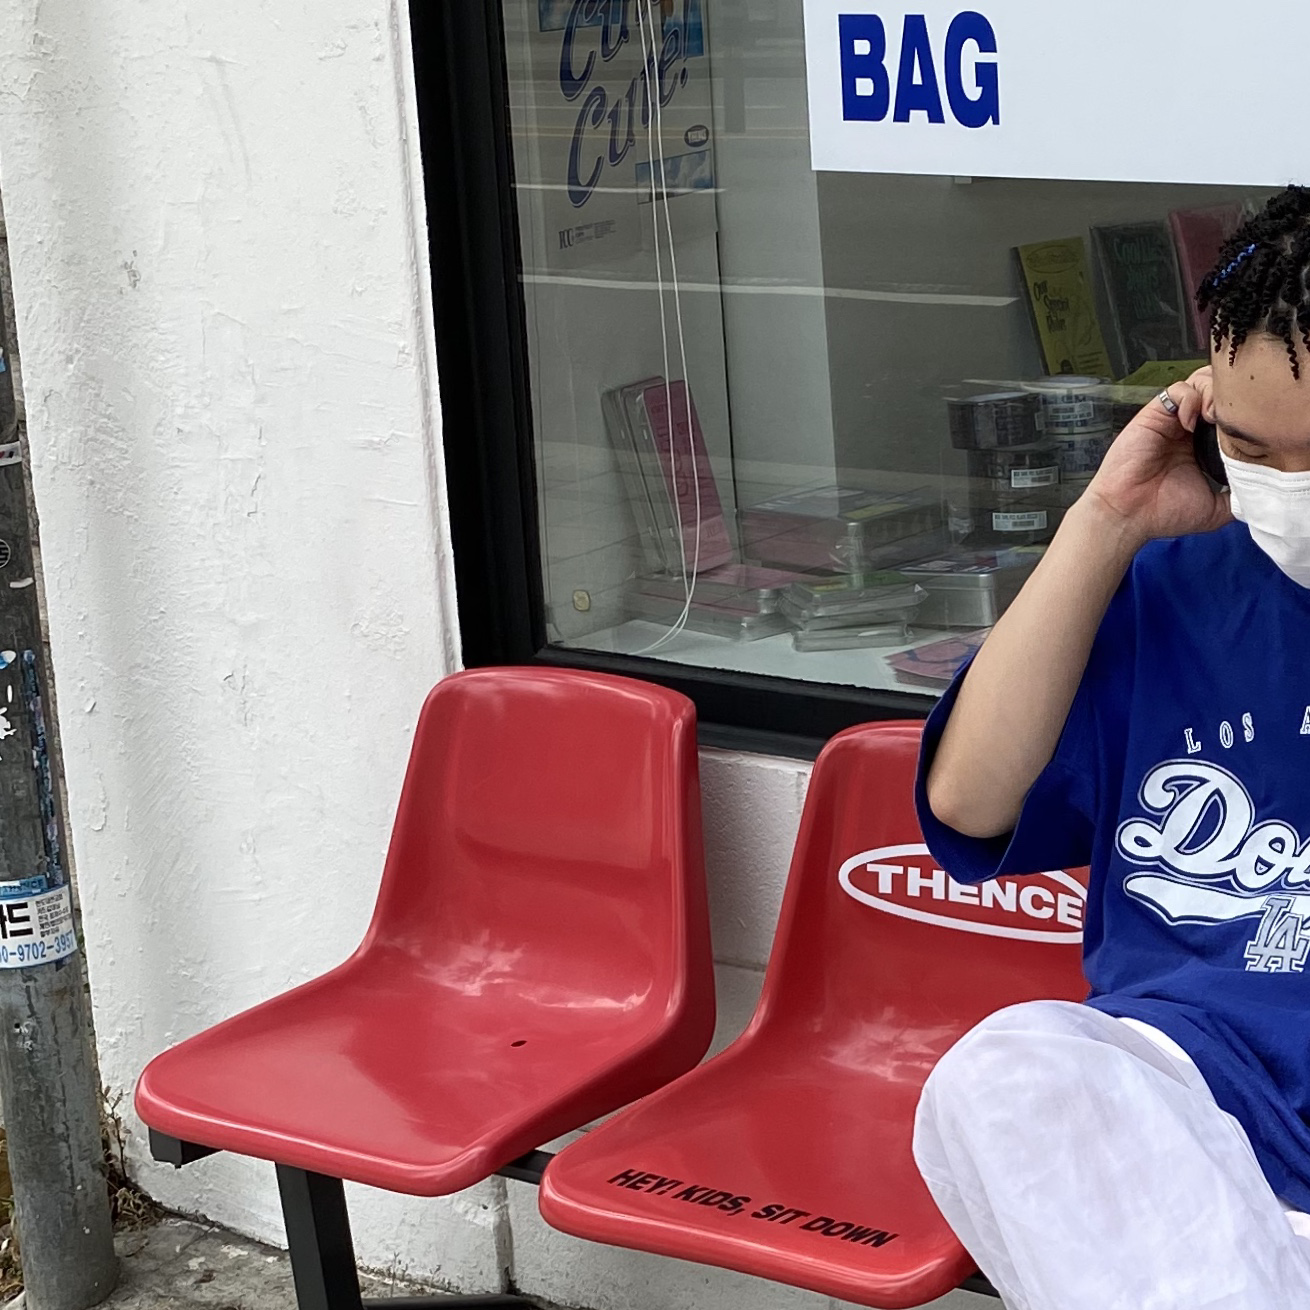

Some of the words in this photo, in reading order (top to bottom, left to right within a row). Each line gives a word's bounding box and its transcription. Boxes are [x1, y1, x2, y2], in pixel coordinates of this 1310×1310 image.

[838, 11, 1000, 128] BAG
[1183, 712, 1256, 754] LOS
[0, 902, 33, 939] 드
[866, 863, 1084, 930] THENCE
[0, 929, 73, 963] 0-9702-3957
[607, 1168, 684, 1195] HEY!
[671, 1184, 752, 1216] KIDS,
[751, 1204, 811, 1225] SIT
[799, 1216, 899, 1248] DOWN
